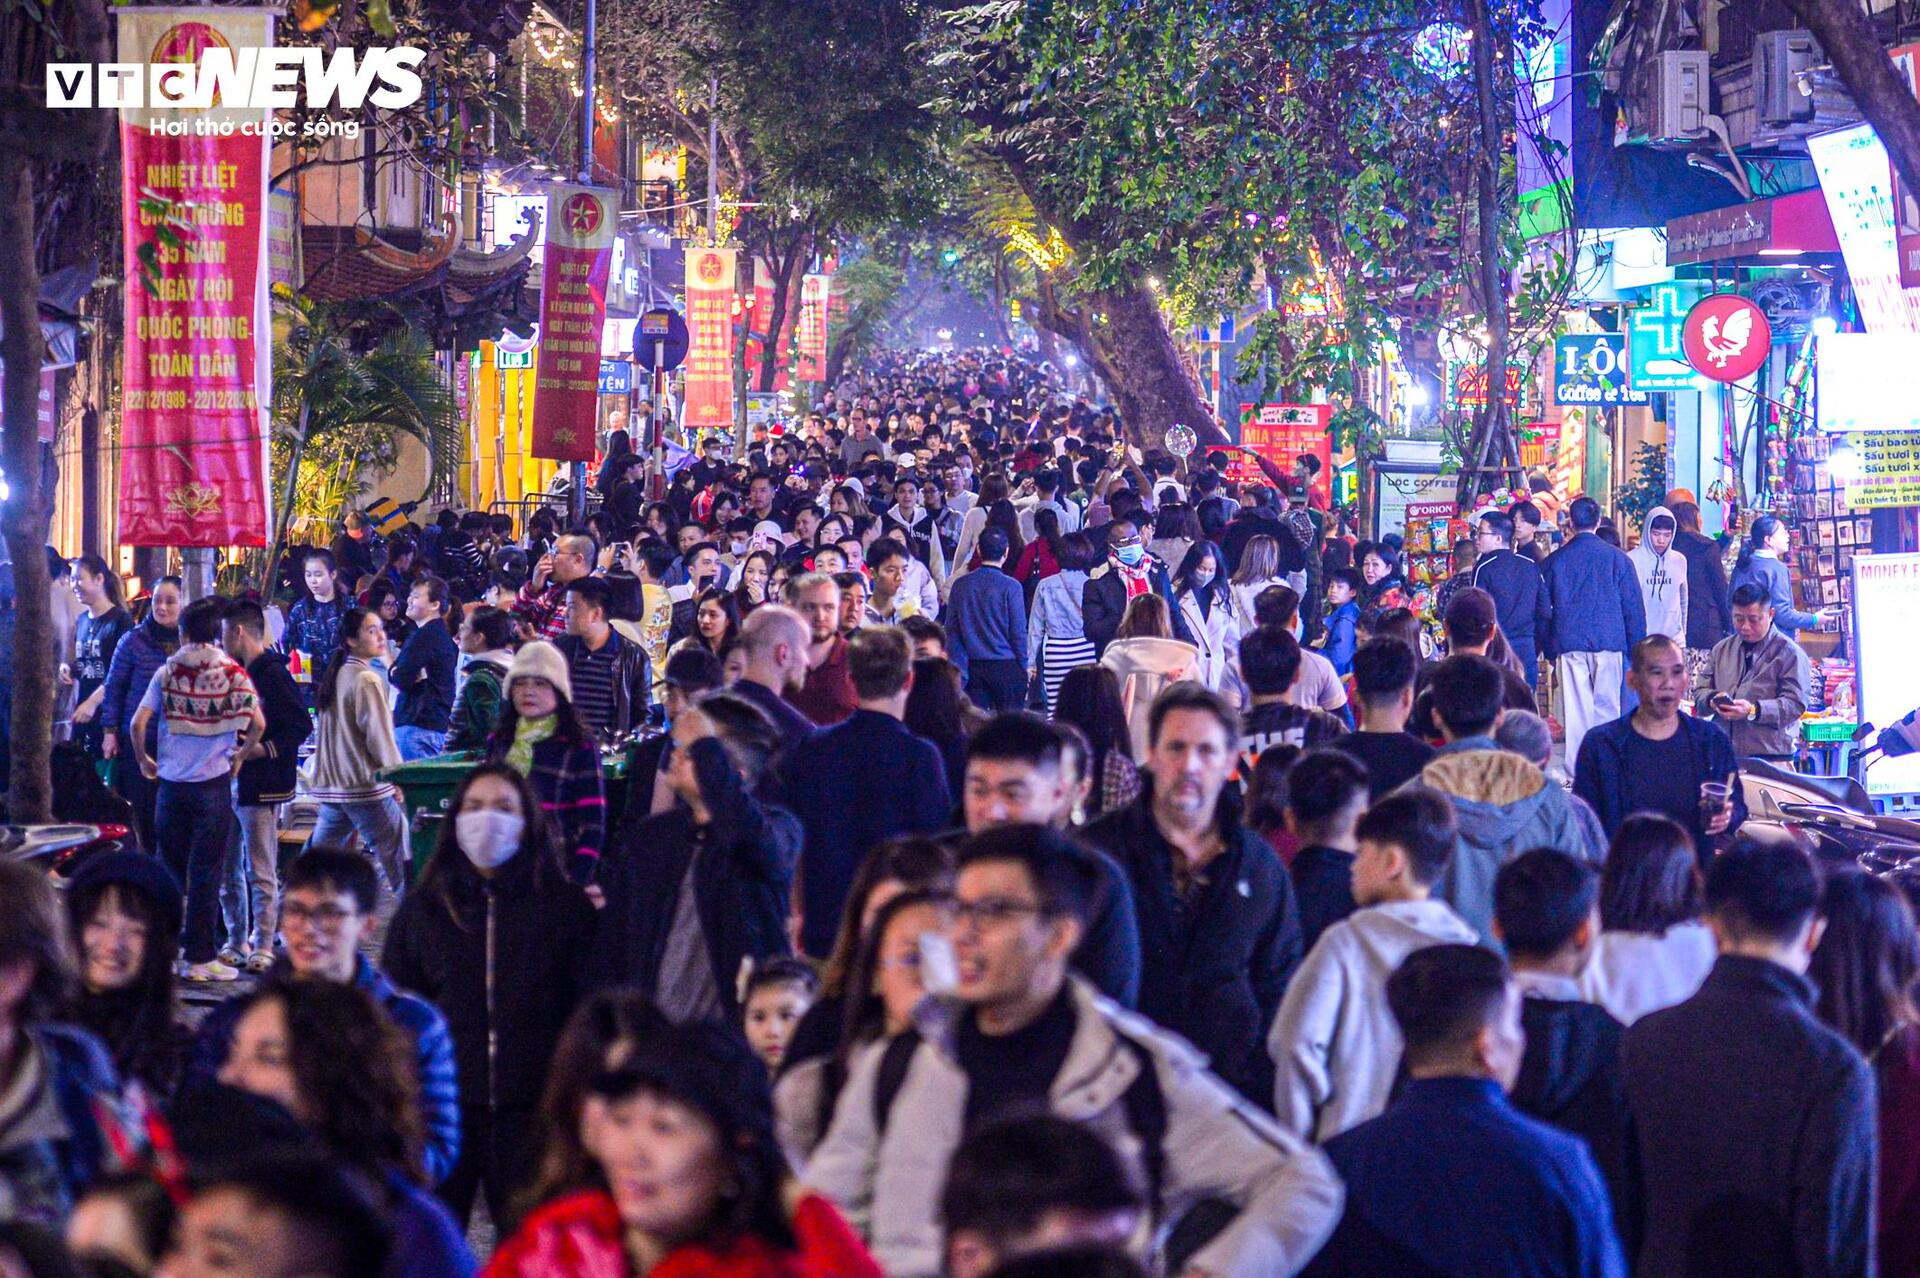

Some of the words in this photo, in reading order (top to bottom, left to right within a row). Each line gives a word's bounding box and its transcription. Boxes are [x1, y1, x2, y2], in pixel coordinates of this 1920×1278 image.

[147, 161, 197, 192] NHIỆT
[202, 160, 238, 192] LIỆT
[136, 308, 183, 342] QUỐC
[188, 310, 249, 340] PHÒNG
[148, 350, 194, 377] TOÀN
[198, 349, 237, 377] DÂN
[1557, 383, 1602, 402] Coffee
[1887, 438, 1909, 447] bao
[1421, 505, 1453, 515] ORION
